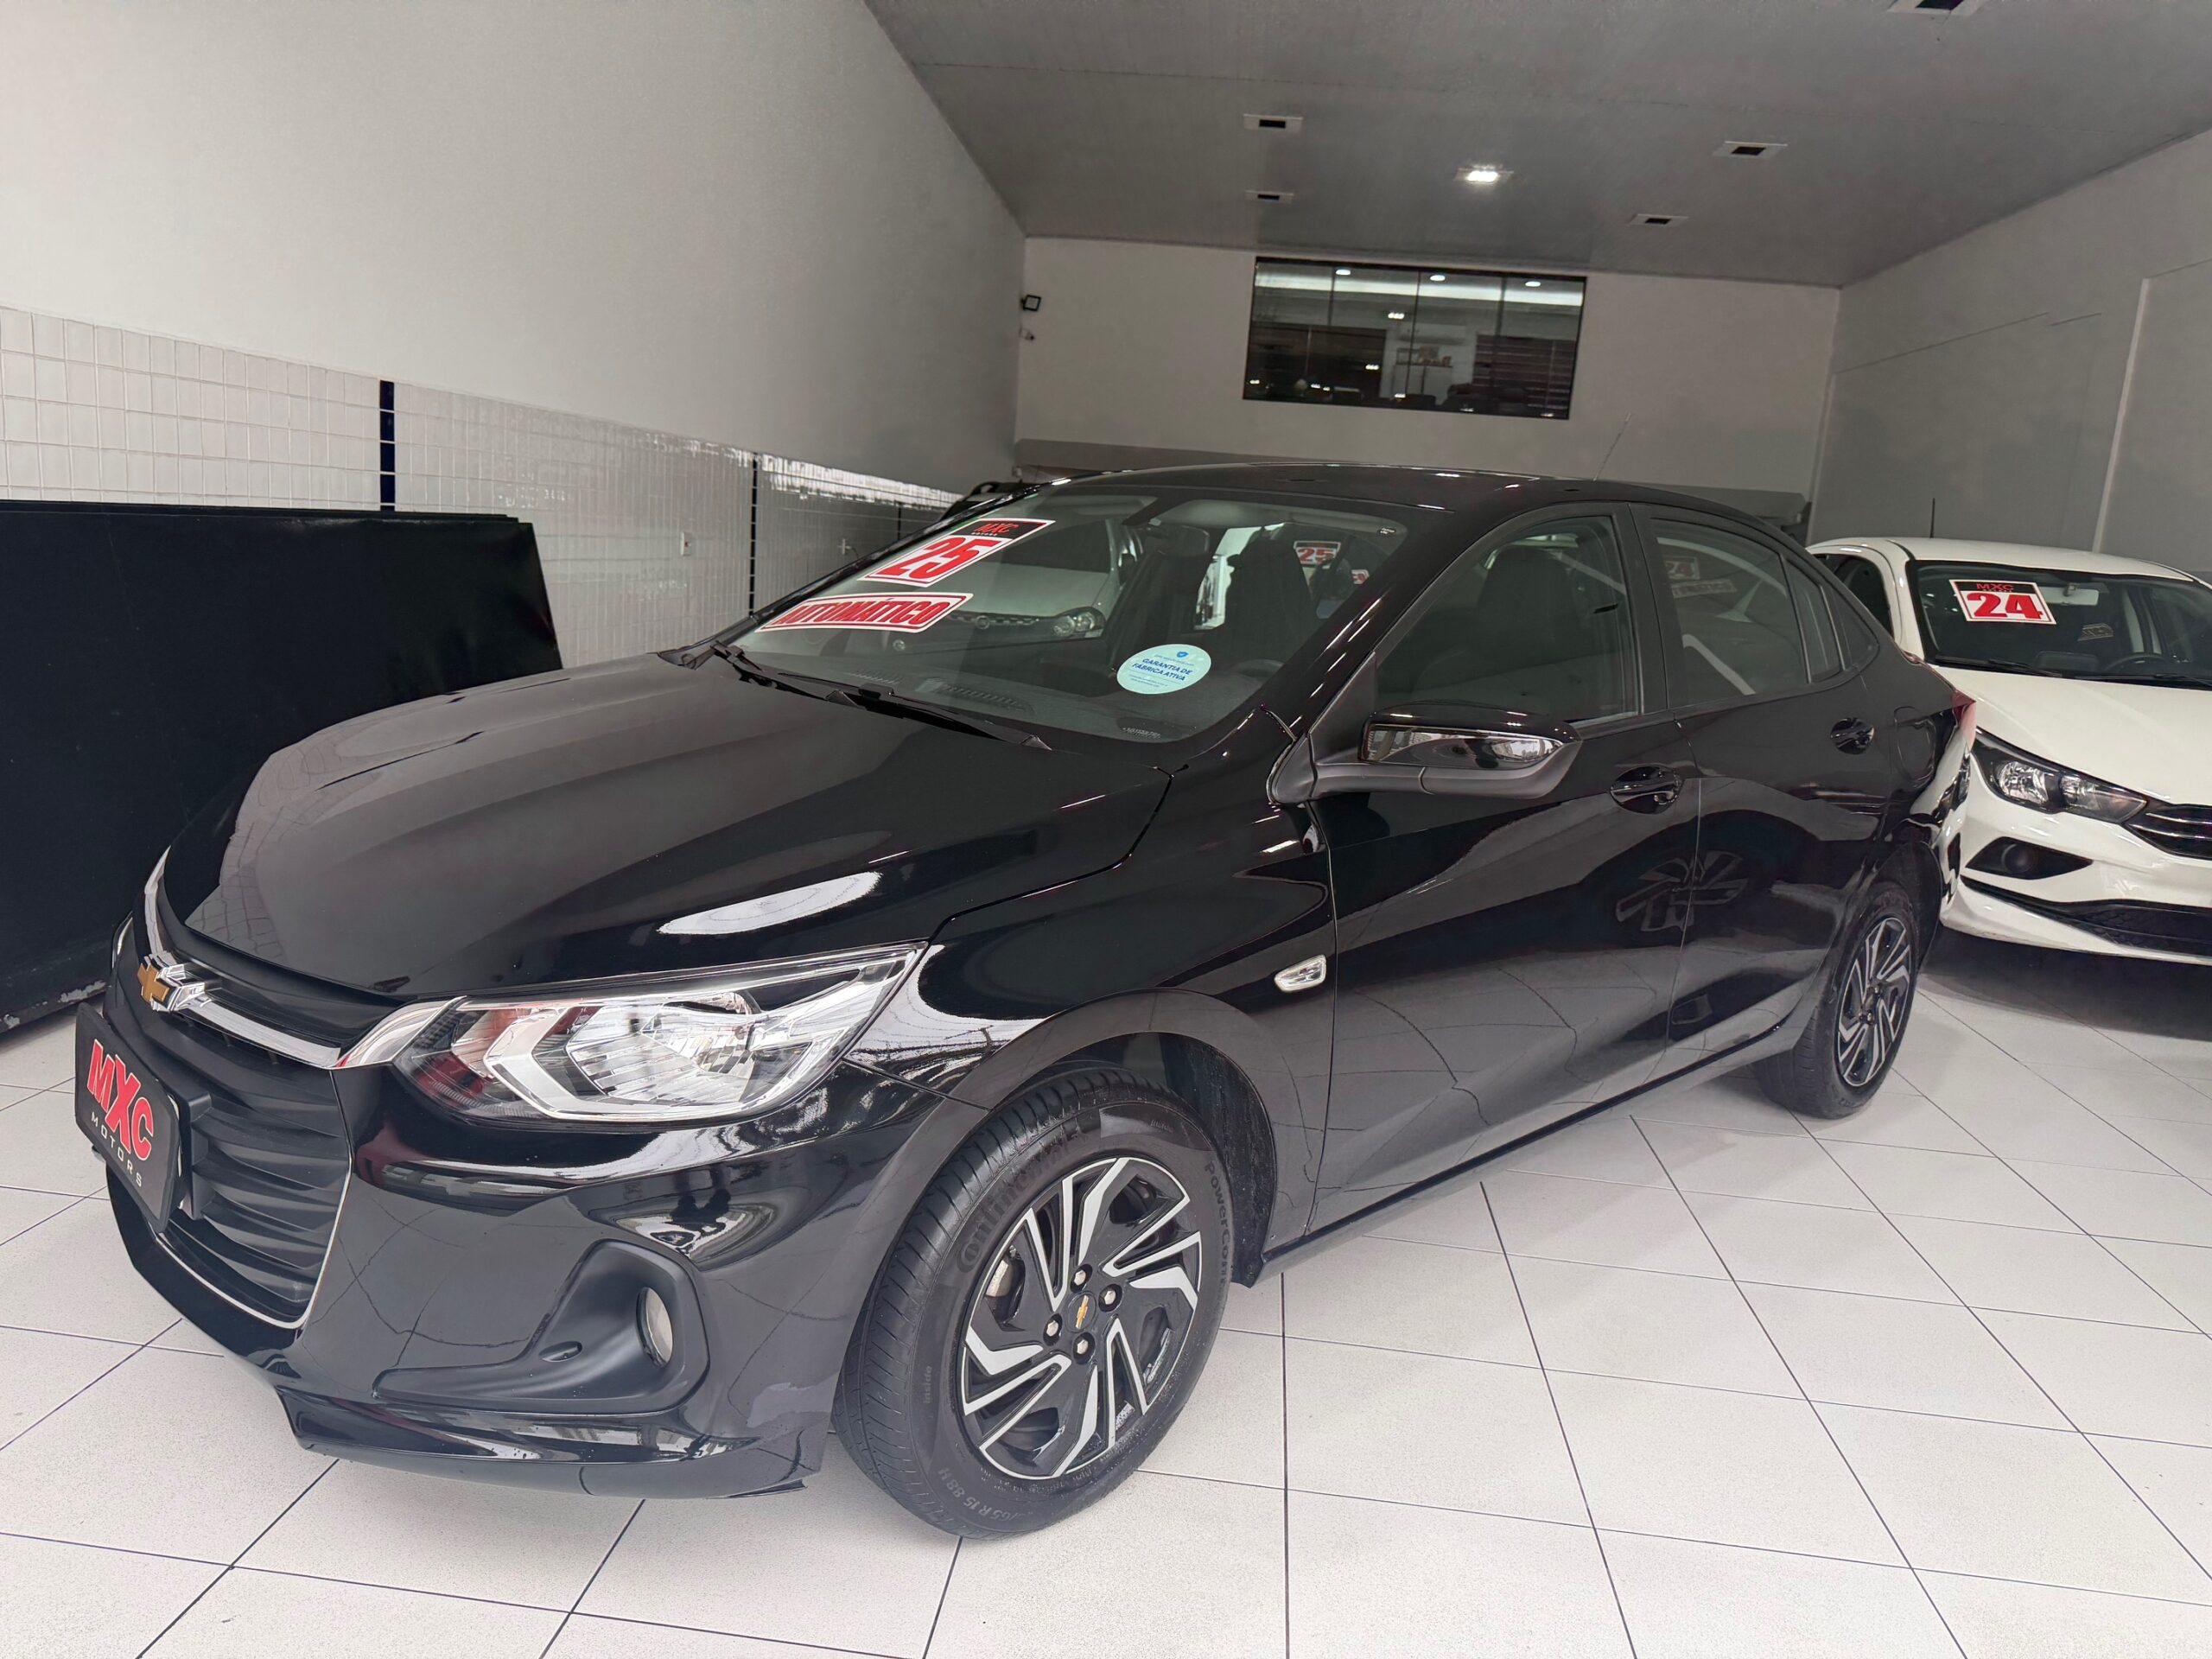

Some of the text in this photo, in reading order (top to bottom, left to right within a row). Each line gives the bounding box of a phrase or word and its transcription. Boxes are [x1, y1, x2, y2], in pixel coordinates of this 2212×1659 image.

[874, 537, 1003, 580] 25
[1297, 547, 1336, 563] 25
[776, 598, 950, 625] AUTOMÁTICO
[1967, 593, 2044, 620] 24
[1142, 658, 1181, 672] GARANTIA
[1163, 671, 1186, 681] ATIVA
[86, 1039, 154, 1161] MXC
[91, 1111, 143, 1188] MOTORS
